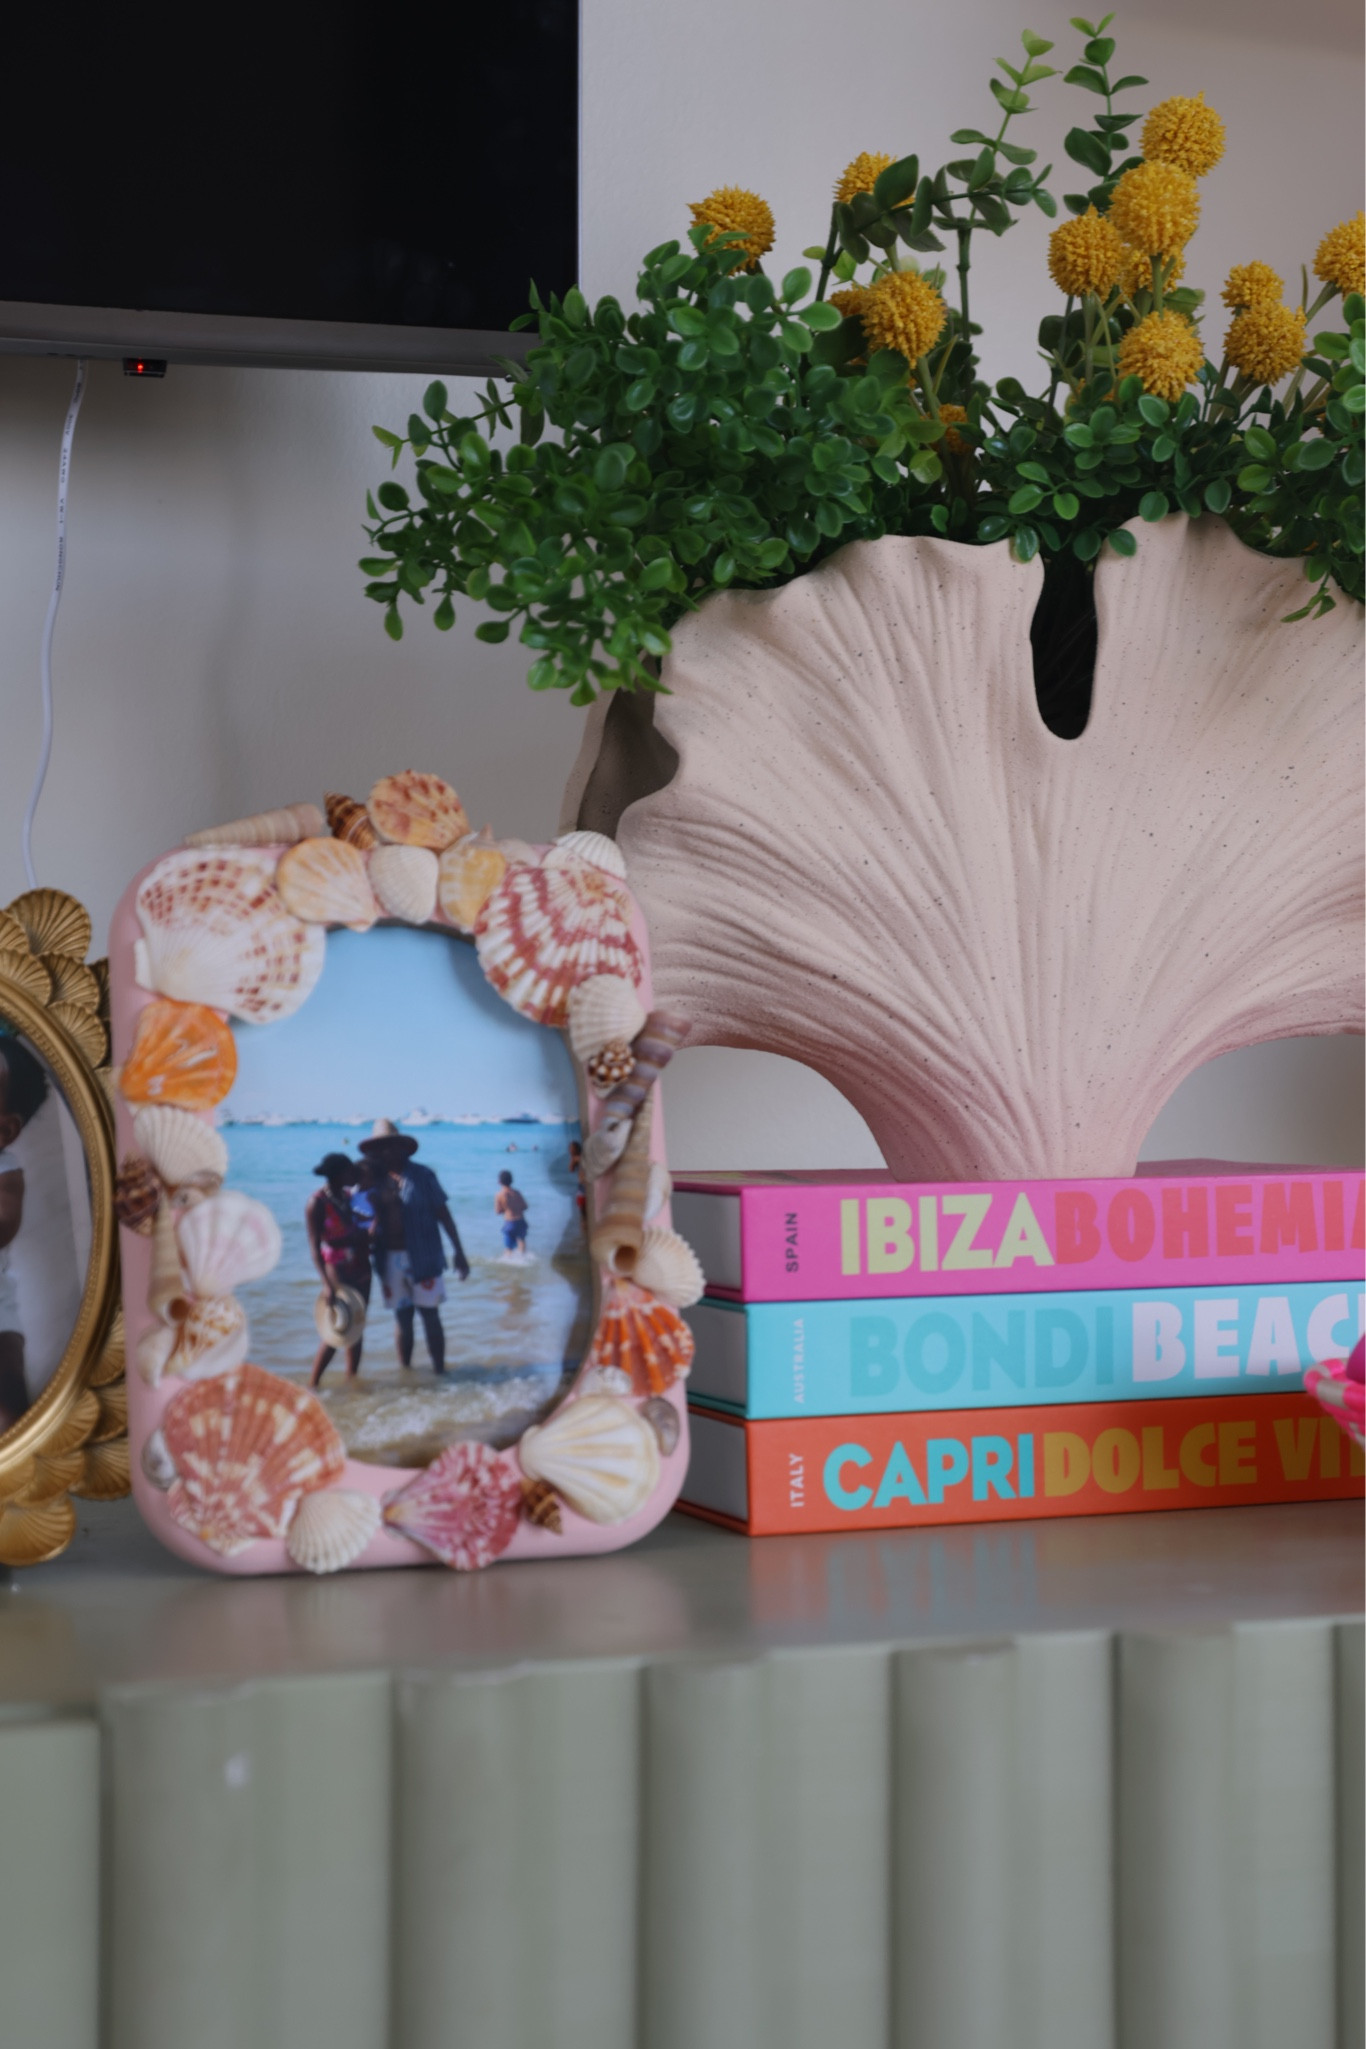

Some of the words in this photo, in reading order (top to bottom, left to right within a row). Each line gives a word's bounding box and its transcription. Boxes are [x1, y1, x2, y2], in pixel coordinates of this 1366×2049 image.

[785, 1212, 799, 1273] SPAIN
[840, 1192, 1055, 1276] IBIZA
[793, 1317, 805, 1404] AUSTRALIA
[849, 1306, 1115, 1397] BONDI
[1132, 1293, 1365, 1383] BEAC
[788, 1452, 805, 1508] ITALY
[823, 1433, 1035, 1512] CAPRI
[1042, 1419, 1259, 1496] DOLCE
